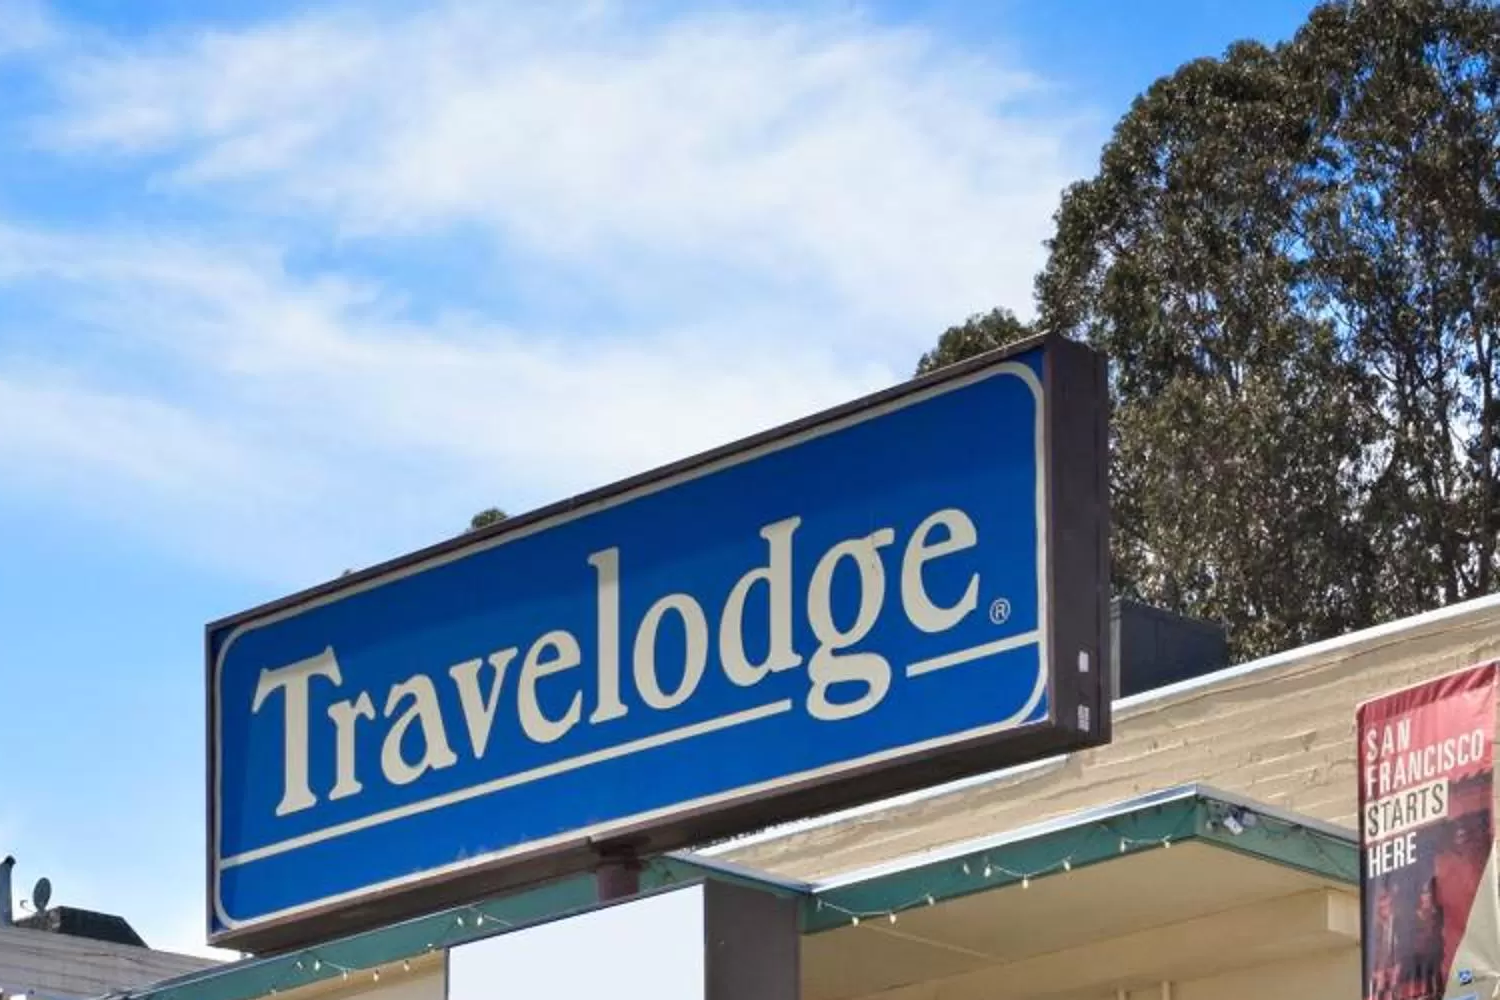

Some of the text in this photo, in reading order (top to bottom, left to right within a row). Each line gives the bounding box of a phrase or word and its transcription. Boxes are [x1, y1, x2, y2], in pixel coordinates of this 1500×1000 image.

[251, 508, 980, 817] Travelodge
[1366, 718, 1412, 763] SAN
[1366, 728, 1485, 797] FRANCISCO
[1367, 783, 1444, 837] STARTS
[1368, 831, 1417, 879] HERE
